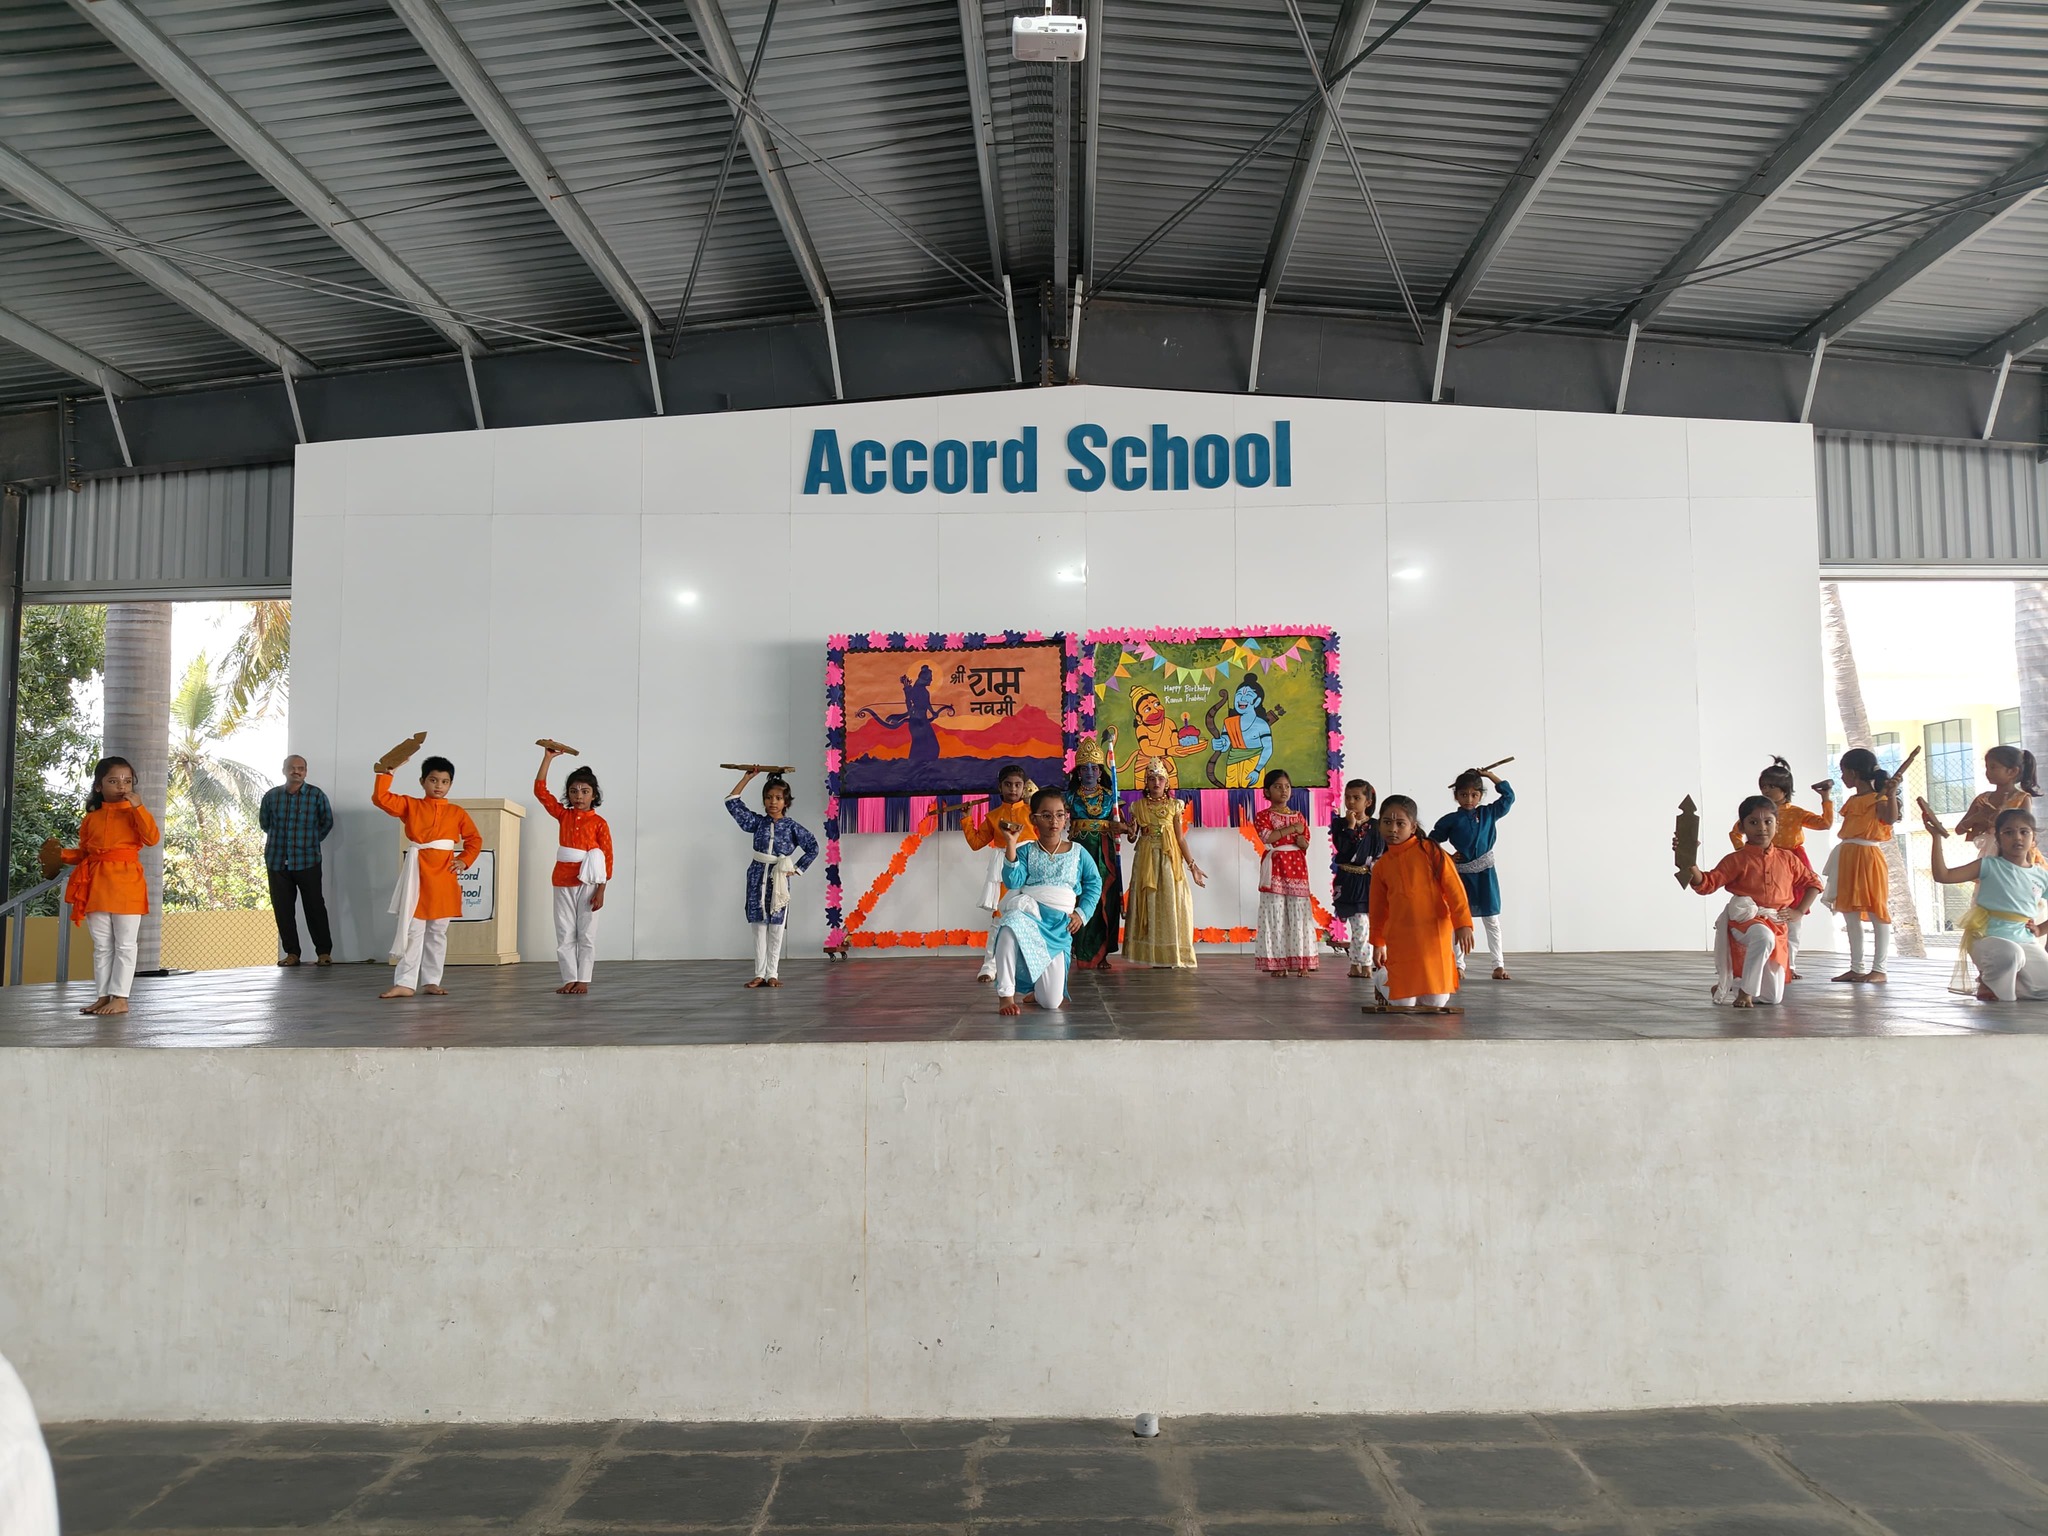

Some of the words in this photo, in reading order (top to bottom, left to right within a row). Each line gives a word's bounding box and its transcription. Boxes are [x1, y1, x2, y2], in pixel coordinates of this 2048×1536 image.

[803, 426, 1038, 495] Accord
[1066, 420, 1292, 492] School
[950, 665, 966, 684] श्री
[967, 667, 1025, 696] राम
[1163, 685, 1182, 694] Happy
[1184, 684, 1211, 695] Birthday
[970, 695, 1016, 716] नवमी
[1165, 695, 1183, 704] Rama
[456, 867, 480, 880] ccord
[461, 885, 481, 897] hool
